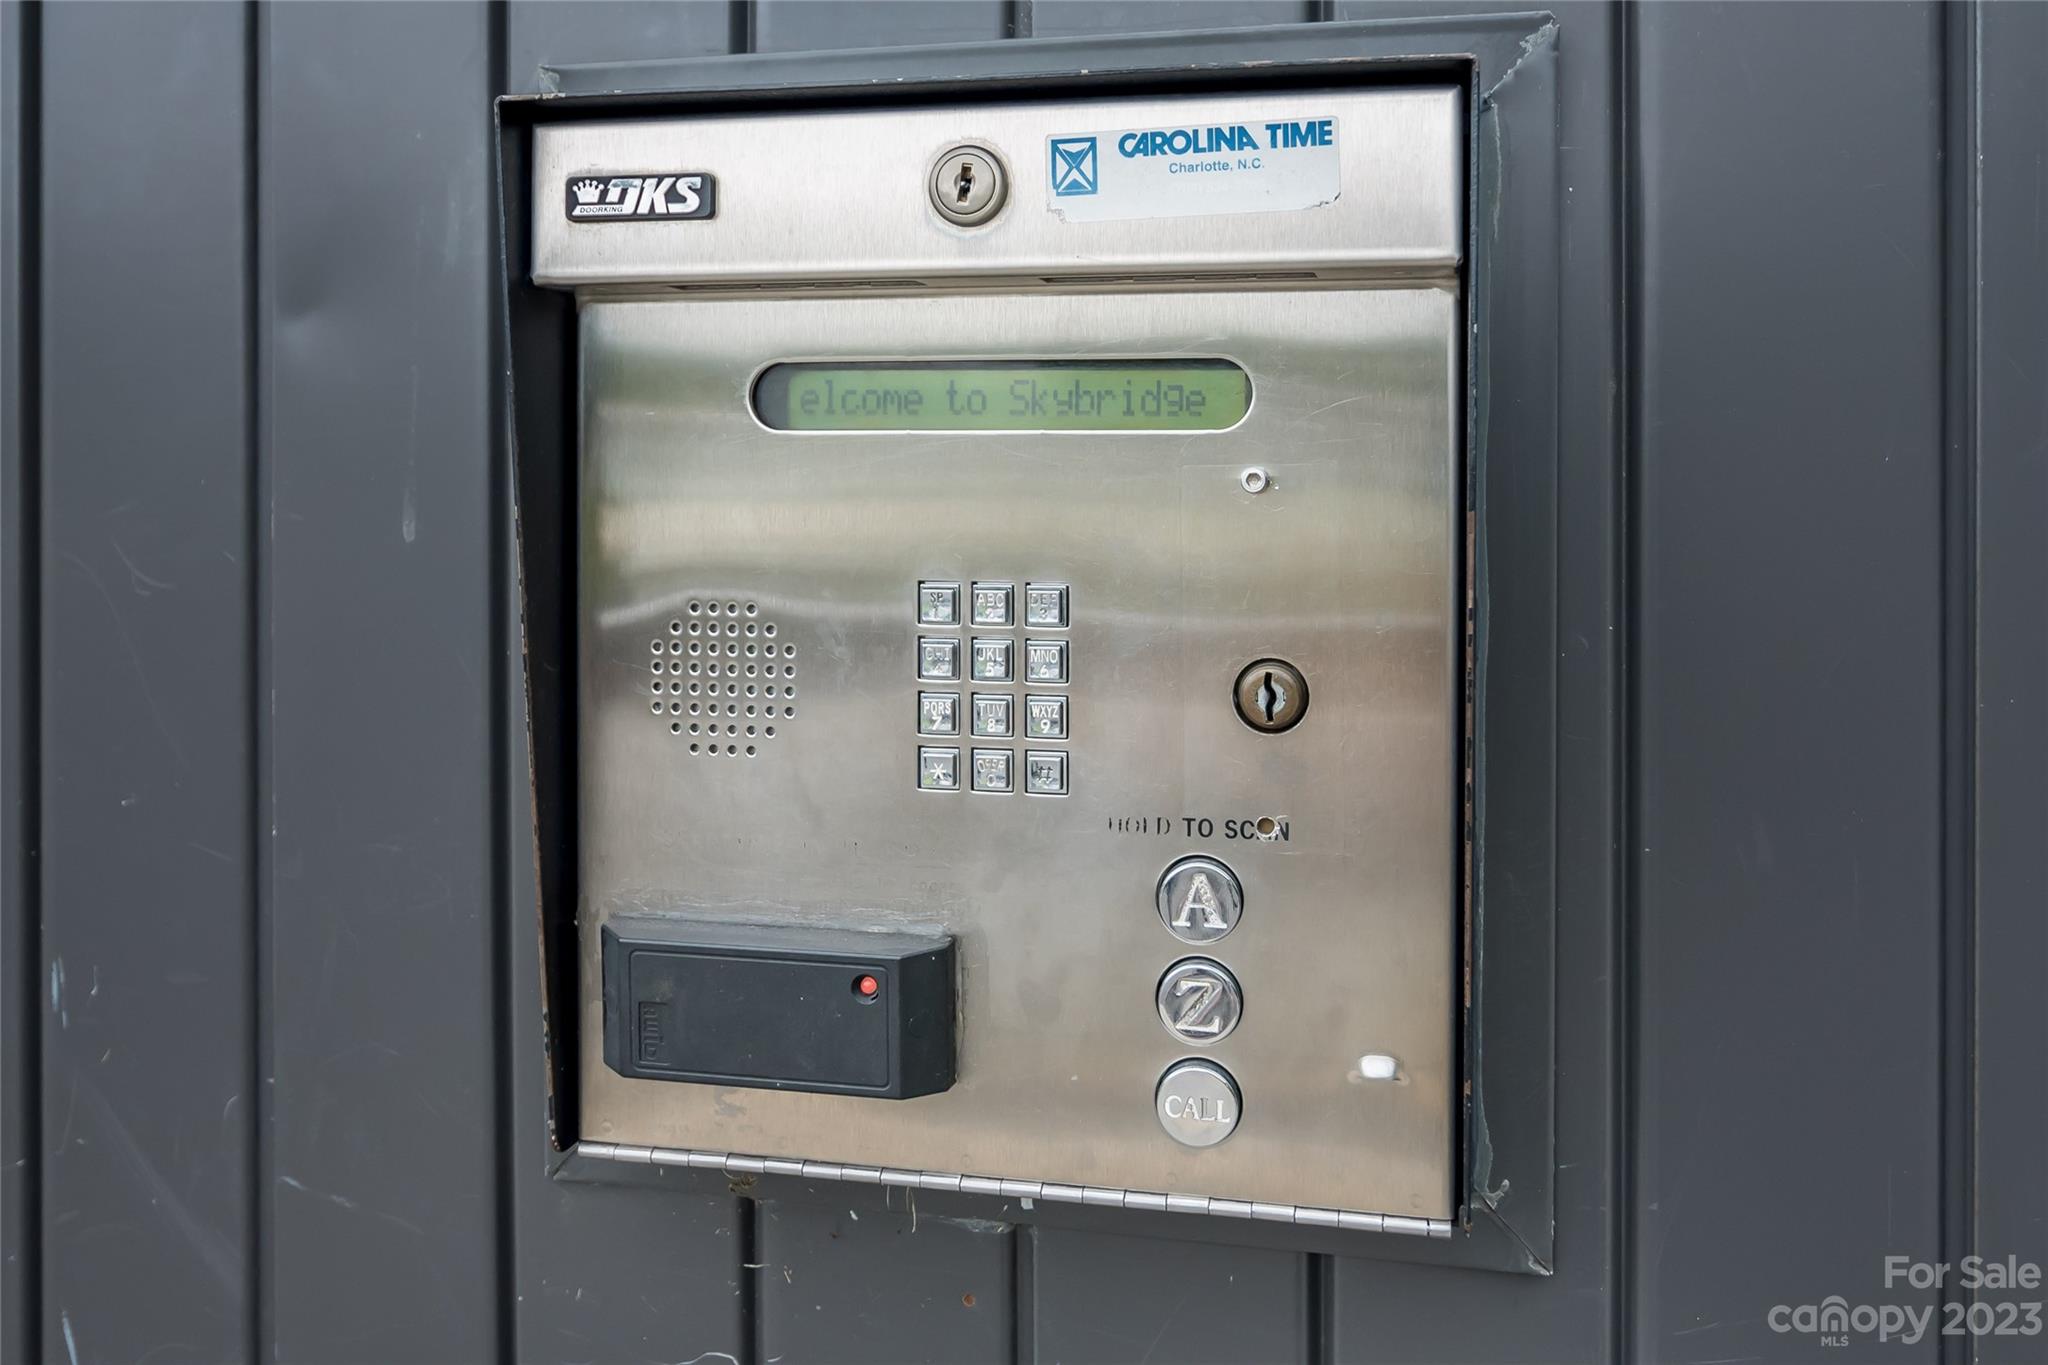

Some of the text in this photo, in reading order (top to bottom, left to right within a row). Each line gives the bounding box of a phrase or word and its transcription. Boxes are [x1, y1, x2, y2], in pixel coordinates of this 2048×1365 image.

[1118, 119, 1333, 158] CAROLINA TIME
[1169, 157, 1266, 174] Charlotte, N.C.
[579, 206, 623, 214] DOORKING
[801, 379, 1207, 418] elcome to Skybridge
[976, 592, 1005, 608] ABC
[976, 648, 1005, 662] JKL
[1030, 649, 1059, 664] MNO
[985, 662, 995, 677] 5
[1038, 664, 1050, 678] 6
[923, 701, 952, 716] PQRS
[977, 703, 1005, 718] TUV
[1031, 705, 1060, 719] WXYZ
[931, 716, 943, 731] 7
[986, 718, 996, 732] 8
[1039, 719, 1051, 734] 9
[1182, 817, 1214, 838] TO
[1224, 818, 1290, 842] SCN
[1172, 872, 1228, 929] A
[1174, 977, 1224, 1034] Z
[1164, 1095, 1231, 1123] CALL
